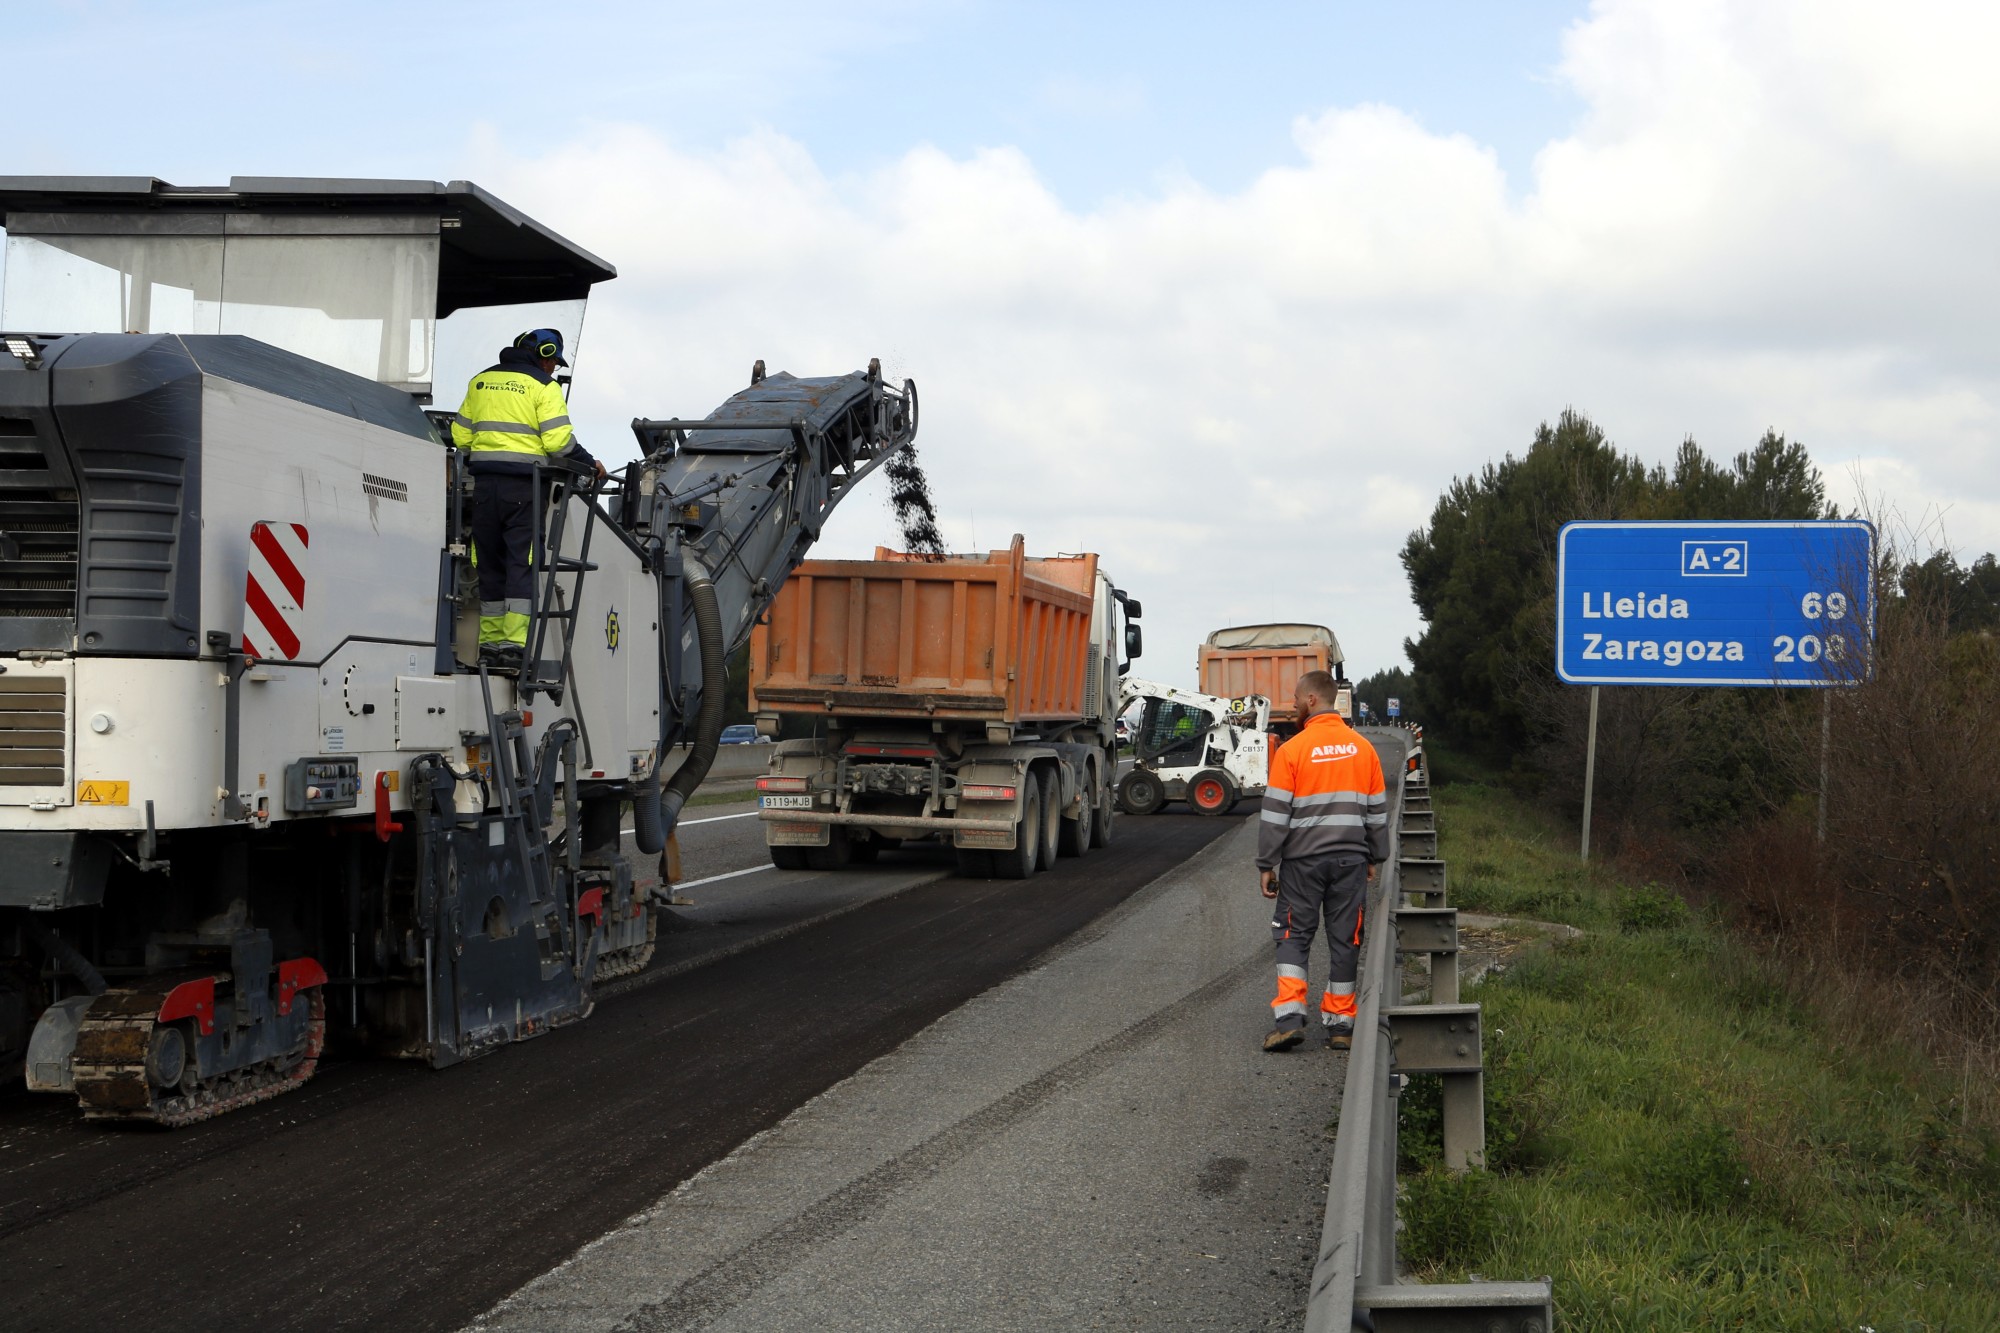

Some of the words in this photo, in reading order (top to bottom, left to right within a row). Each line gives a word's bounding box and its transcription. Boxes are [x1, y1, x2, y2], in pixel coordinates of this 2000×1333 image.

[485, 385, 525, 394] FRESADO
[1689, 547, 1741, 570] A-2
[1582, 591, 1689, 619] Lleida
[1801, 591, 1847, 620] 69
[1582, 633, 1744, 667] Zaragoza
